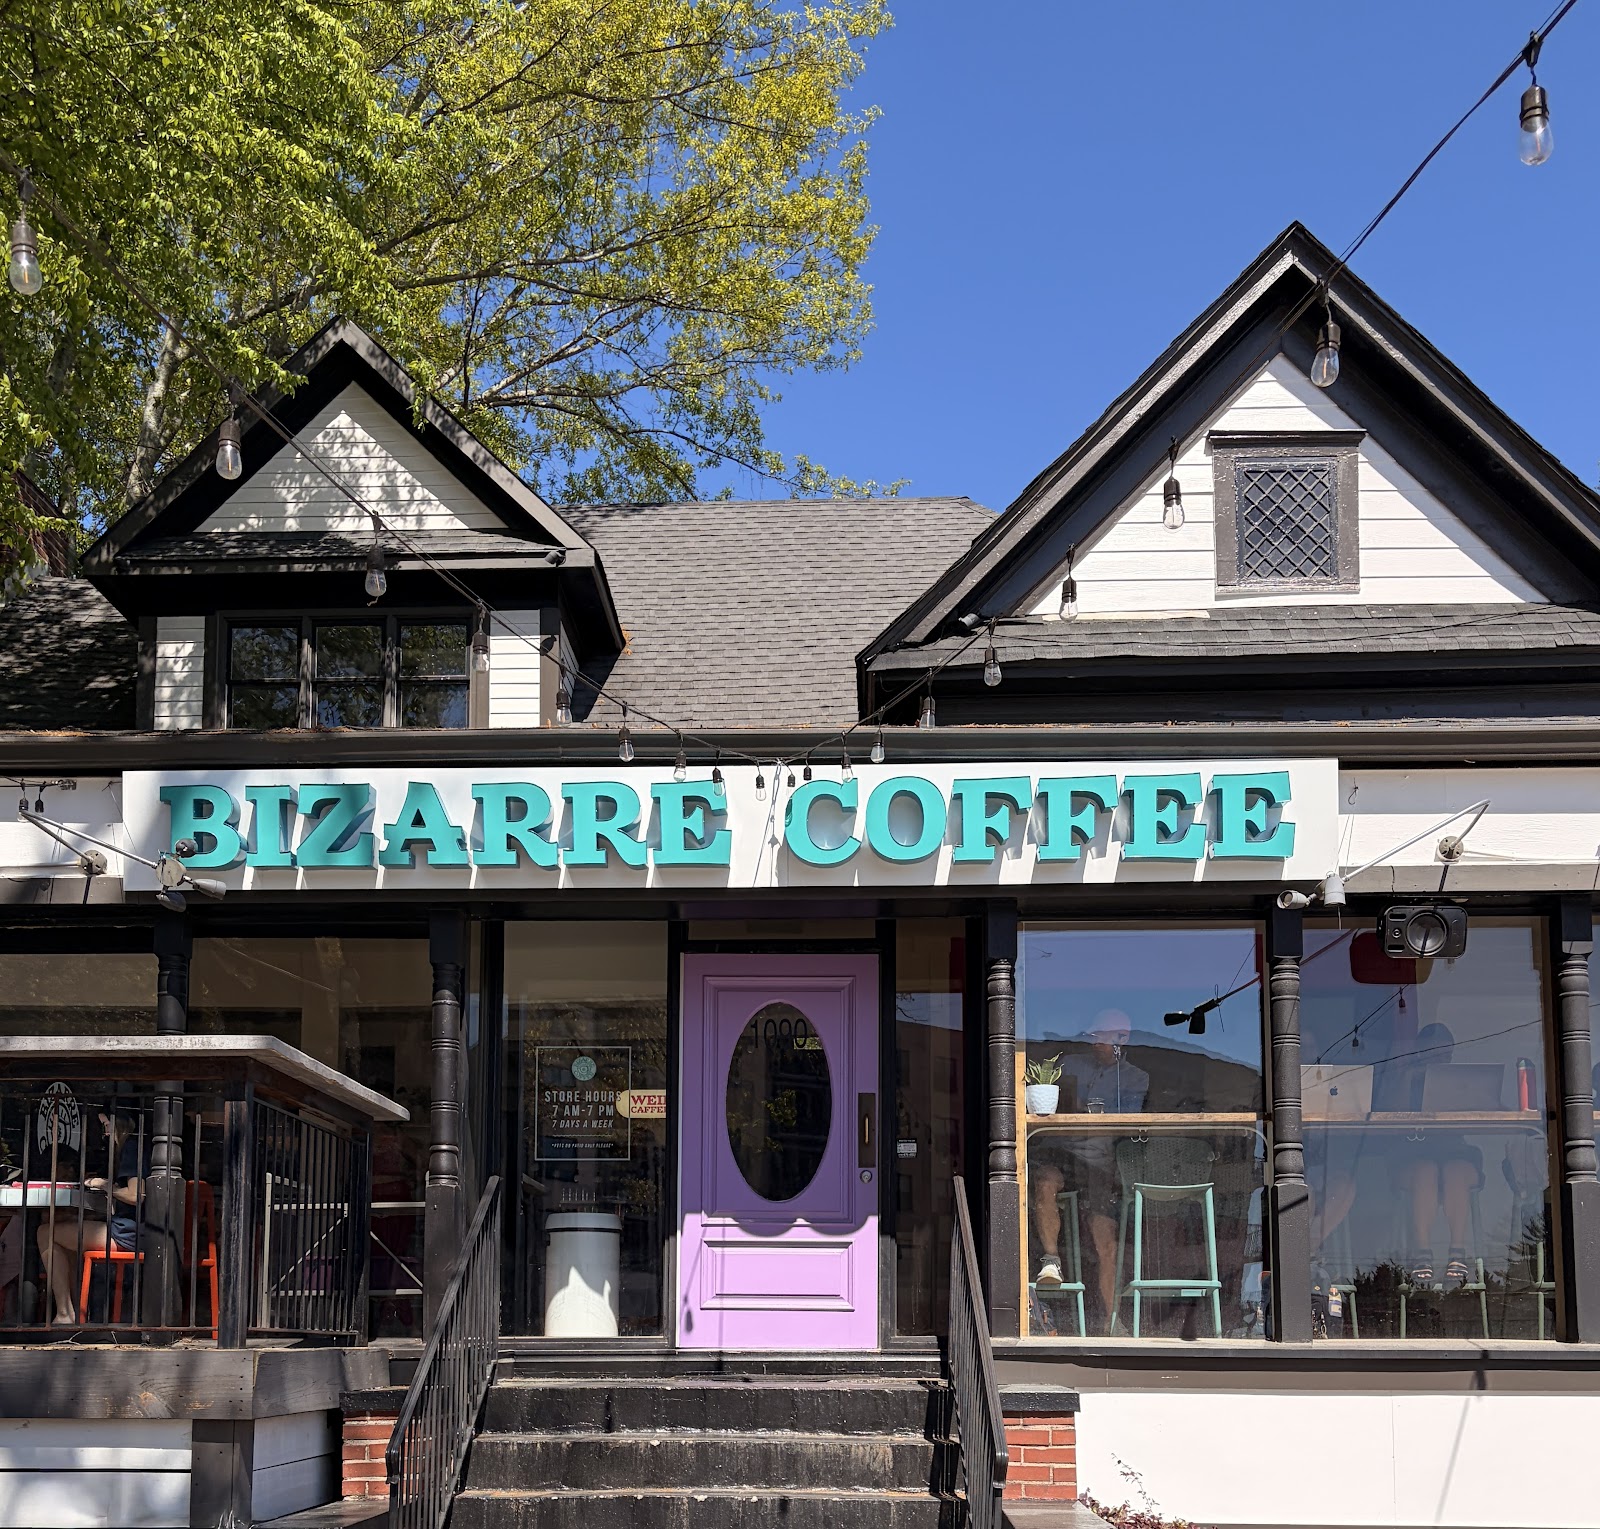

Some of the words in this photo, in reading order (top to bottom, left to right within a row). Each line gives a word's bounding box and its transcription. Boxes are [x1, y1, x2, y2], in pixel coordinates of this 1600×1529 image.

[160, 780, 731, 870] BIZARRE
[785, 771, 1296, 867] COFFEE
[544, 1090, 580, 1102] STORE
[585, 1090, 622, 1102] HOURS
[552, 1105, 559, 1116] 7
[598, 1105, 614, 1116] PM
[552, 1120, 558, 1128] 7
[560, 1120, 580, 1128] DAYS
[583, 1120, 588, 1128] A
[592, 1120, 614, 1128] WEEK
